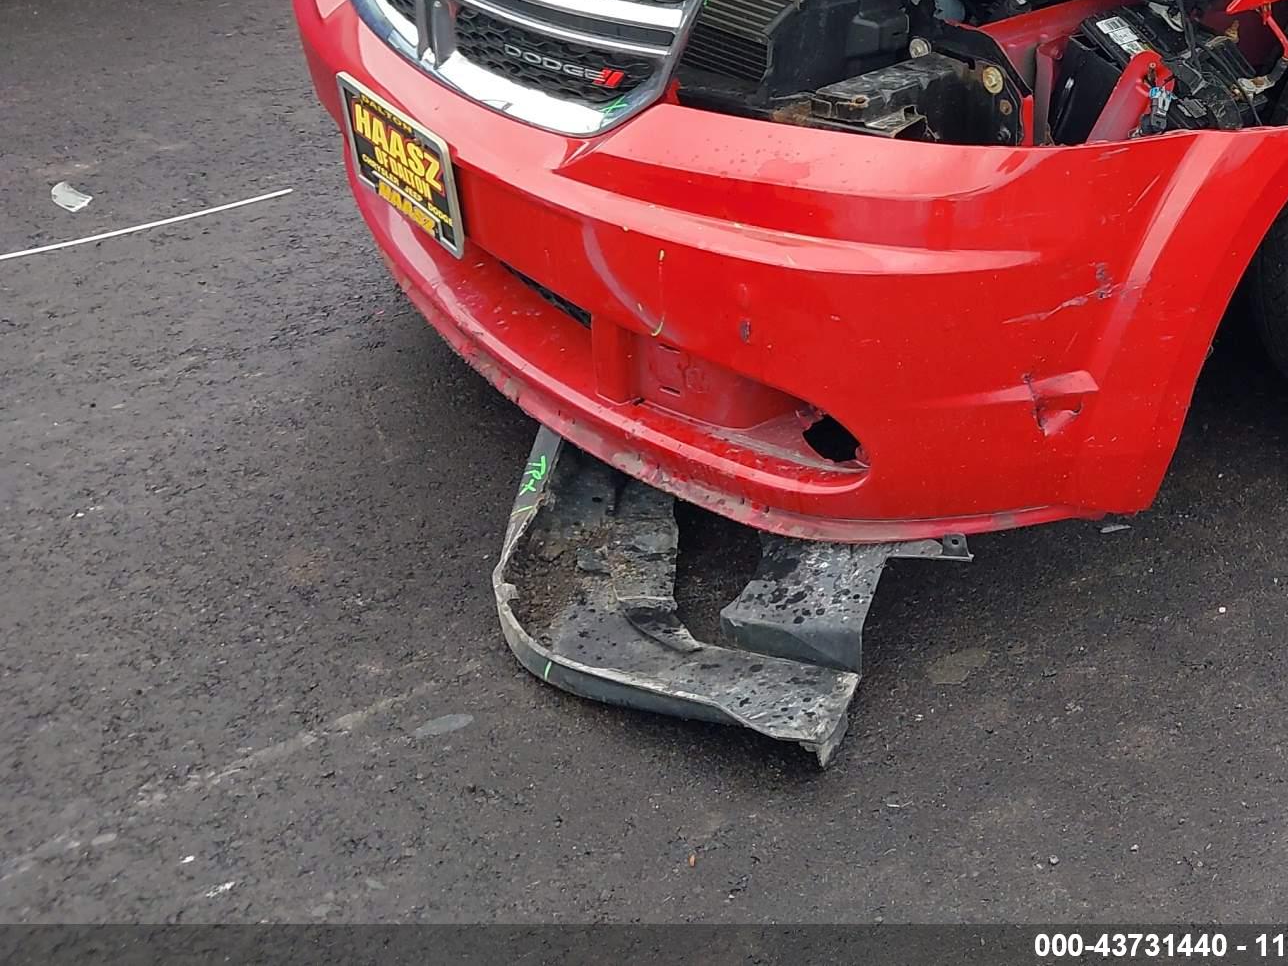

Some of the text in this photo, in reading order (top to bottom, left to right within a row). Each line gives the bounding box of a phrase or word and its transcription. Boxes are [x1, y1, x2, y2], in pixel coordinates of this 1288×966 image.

[504, 43, 607, 83] DODGE
[354, 103, 443, 192] HAASZ
[374, 146, 433, 201] OF DALTON
